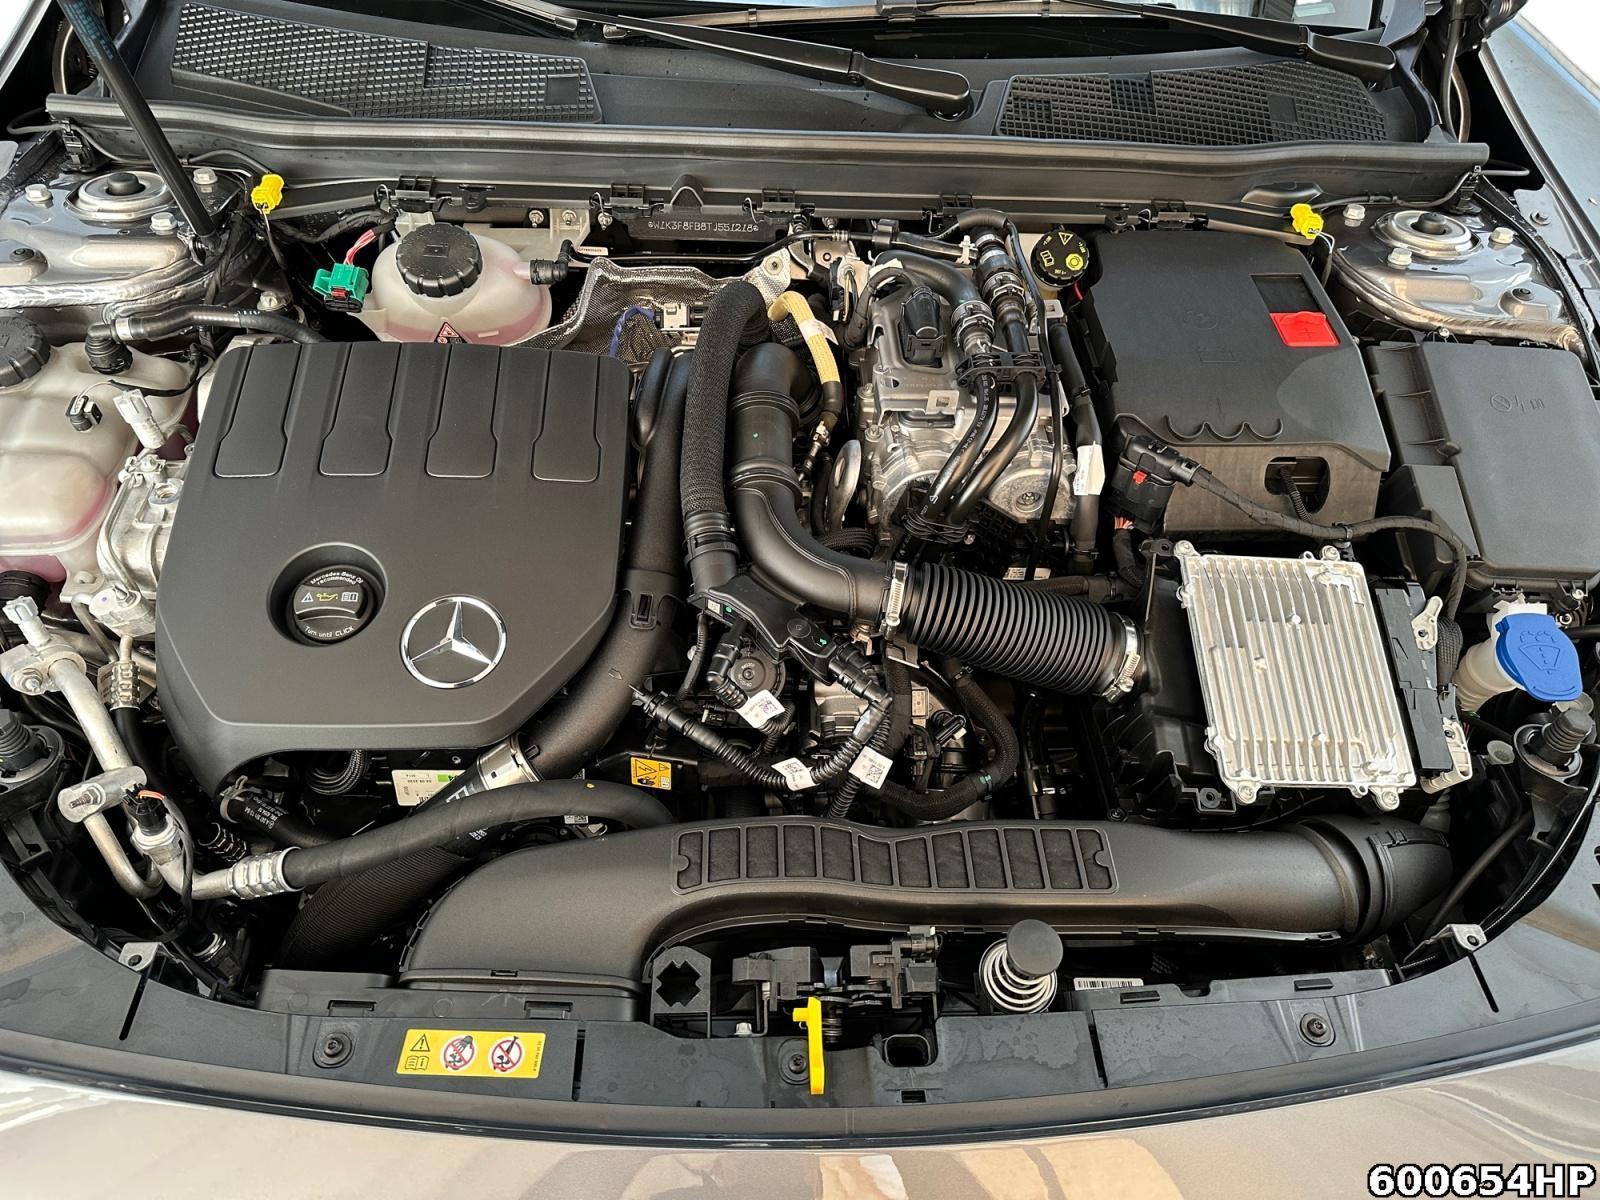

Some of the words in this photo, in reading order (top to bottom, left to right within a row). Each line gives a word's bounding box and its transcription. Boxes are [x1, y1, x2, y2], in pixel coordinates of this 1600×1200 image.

[317, 576, 357, 585] recommended
[305, 625, 317, 636] Turn
[335, 625, 355, 637] CLICK
